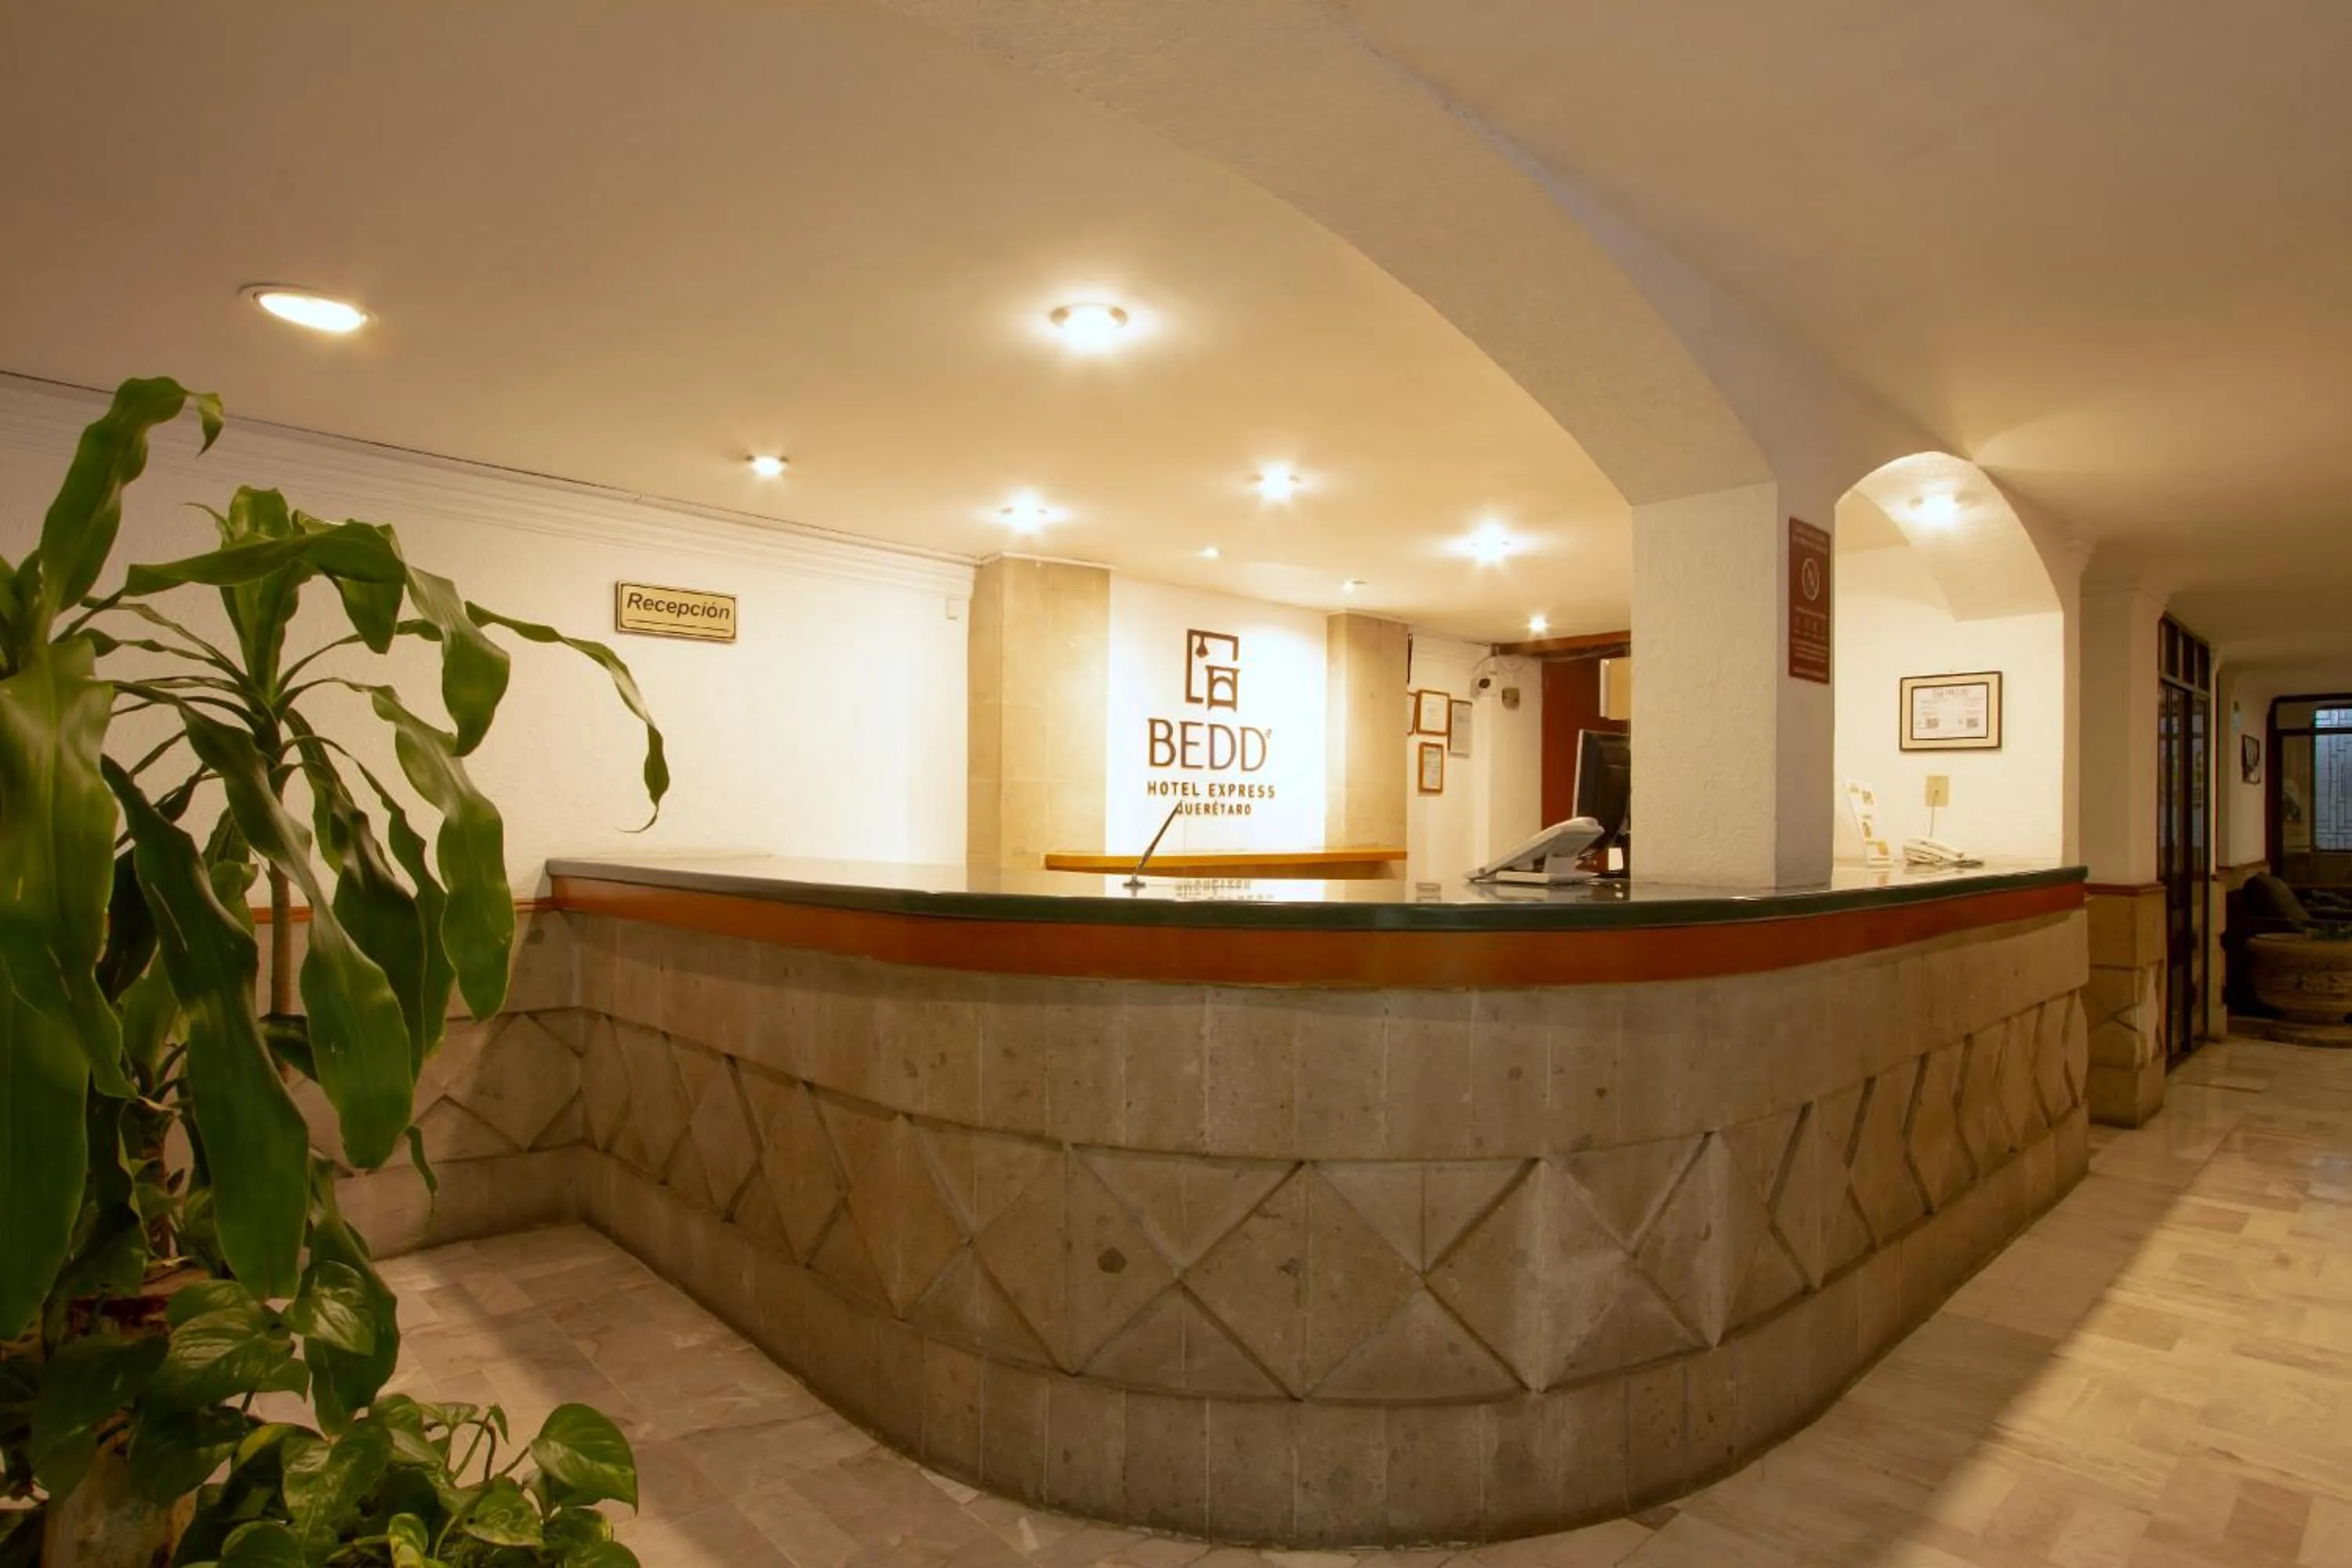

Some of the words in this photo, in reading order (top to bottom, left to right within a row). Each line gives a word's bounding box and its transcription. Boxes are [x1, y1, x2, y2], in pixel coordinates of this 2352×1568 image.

[626, 592, 731, 619] Recepción
[1147, 781, 1201, 797] HOTEL
[1208, 782, 1276, 799] EXPRESS
